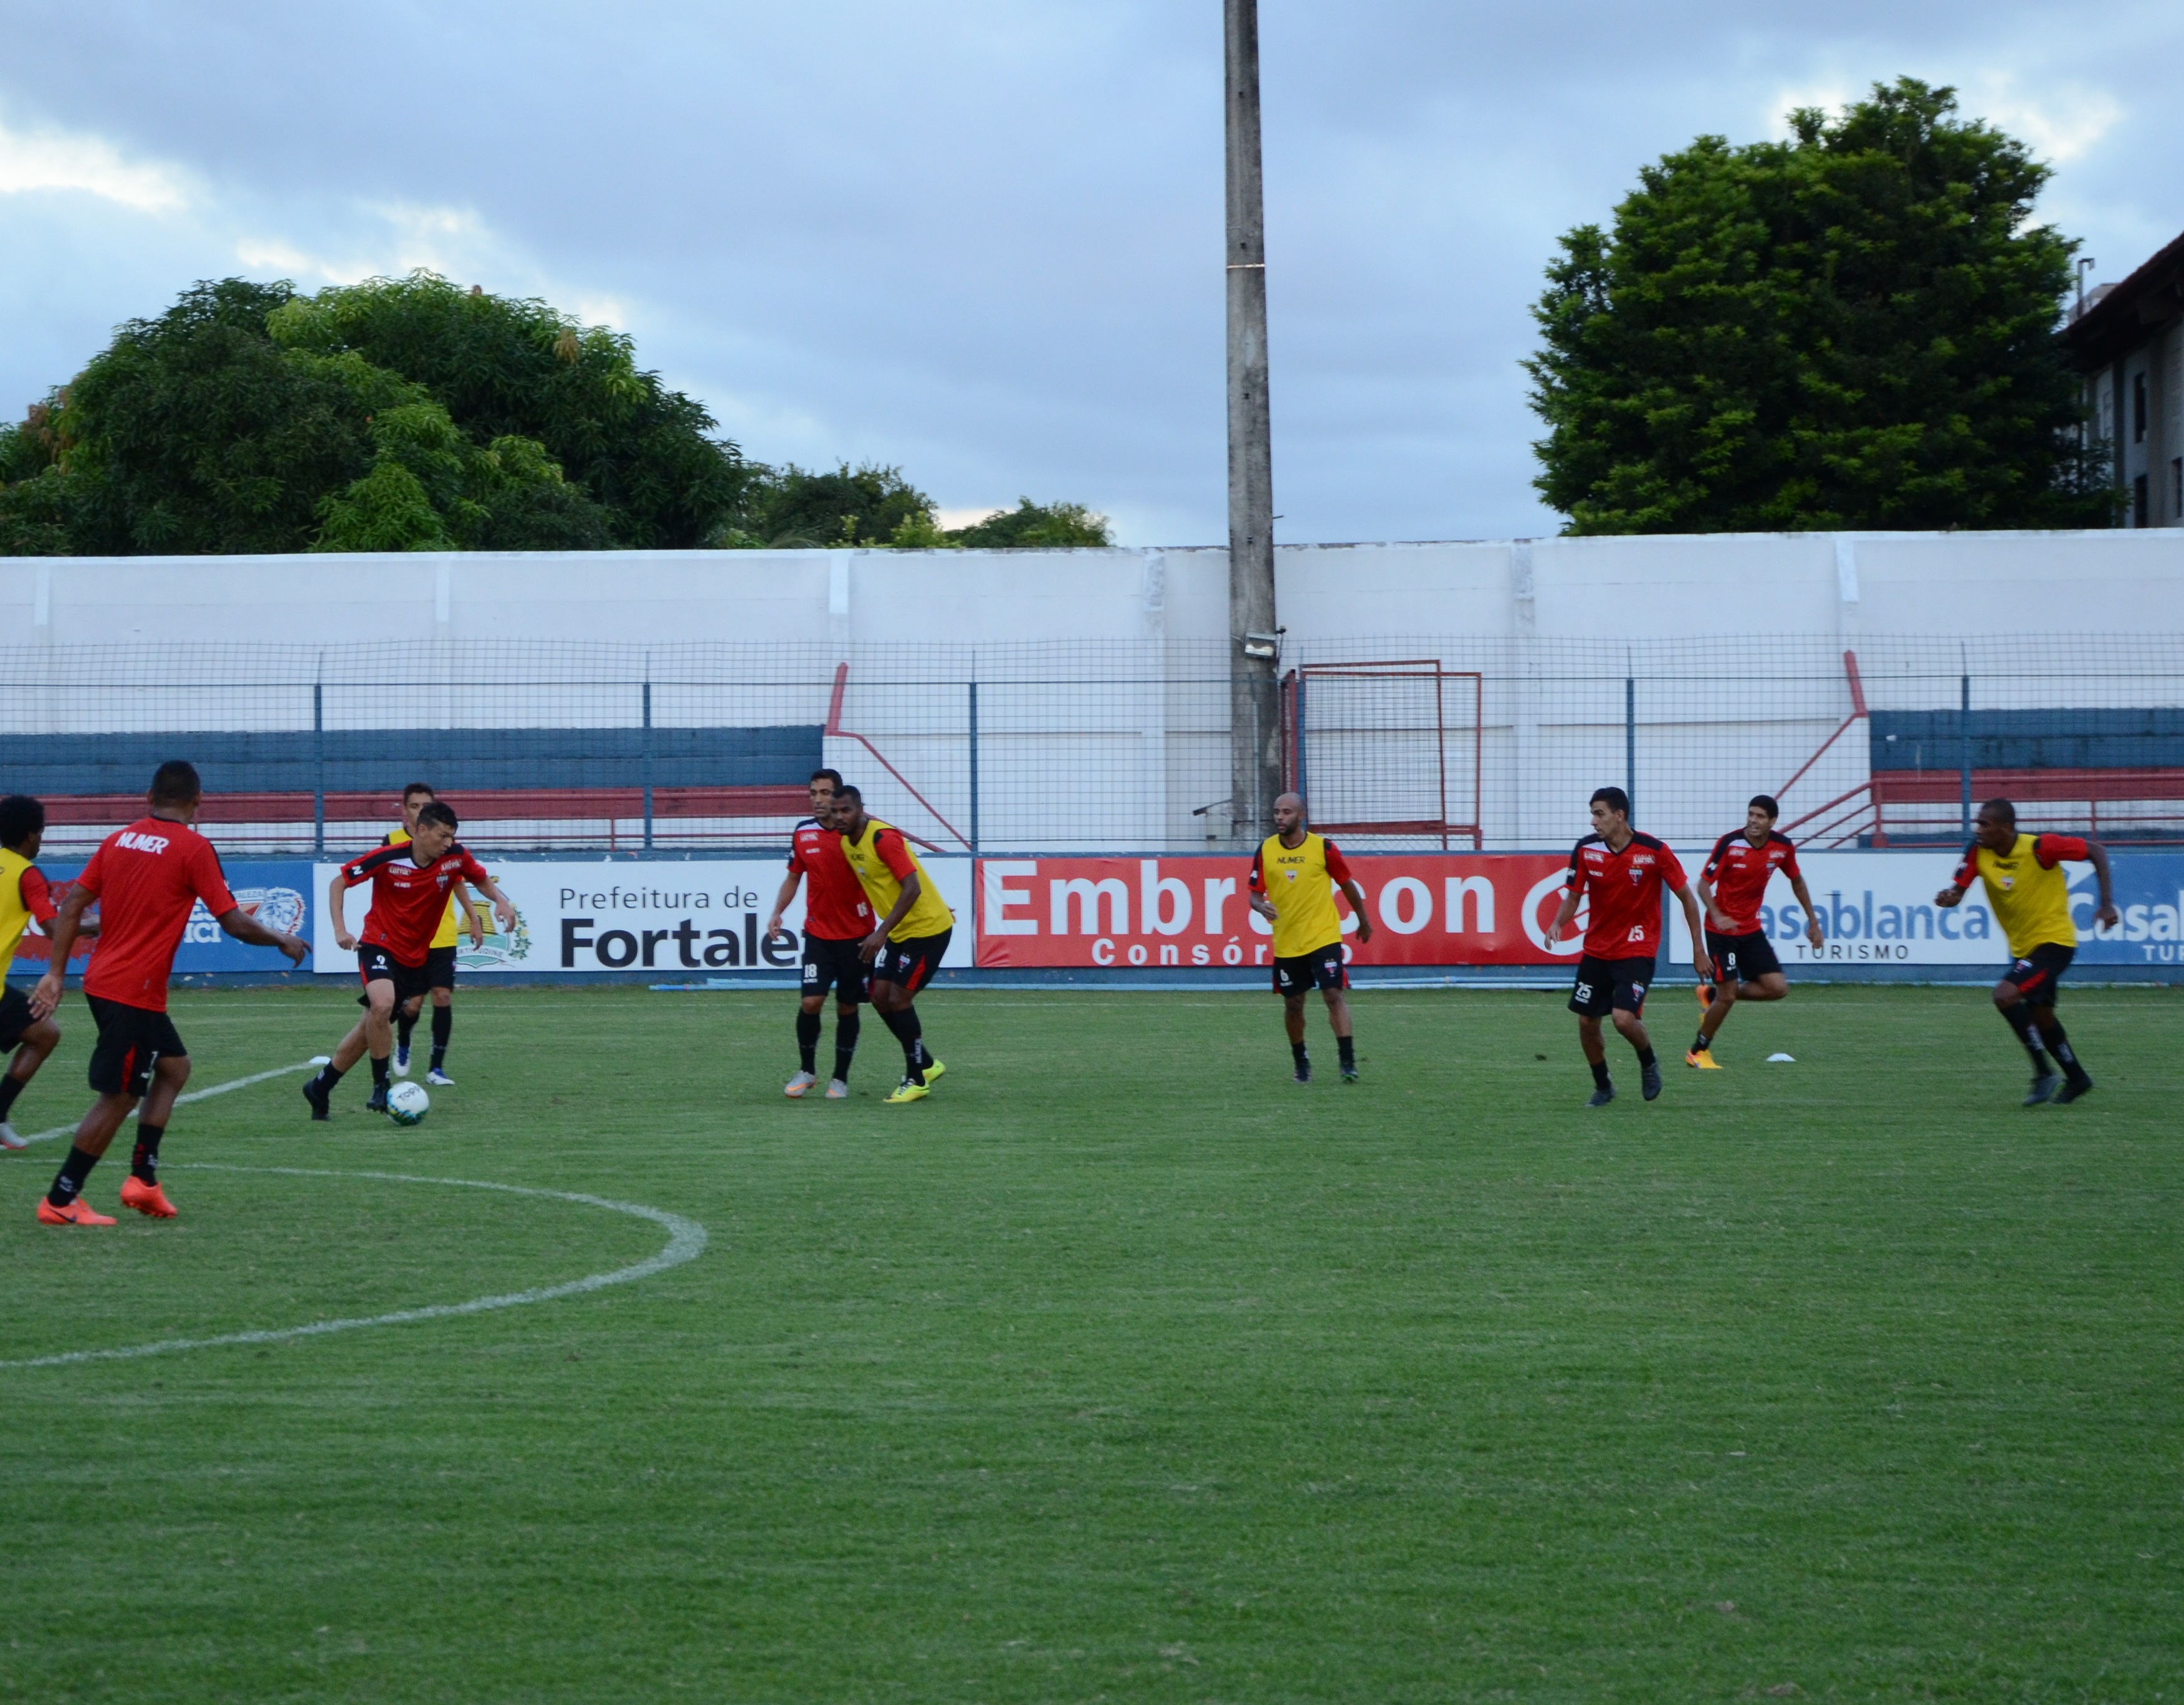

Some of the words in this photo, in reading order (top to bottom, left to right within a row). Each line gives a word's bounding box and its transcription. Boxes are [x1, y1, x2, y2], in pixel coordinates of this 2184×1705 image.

[115, 832, 169, 855] NUMER
[560, 886, 710, 909] Prefeitura
[724, 885, 758, 908] de
[983, 859, 1495, 937] Embrcon
[1758, 890, 1990, 940] asablanca
[560, 913, 805, 968] Fortale
[1091, 936, 1353, 966] Consóro
[1796, 944, 1909, 960] TURISMO
[376, 954, 386, 965] 9
[804, 963, 818, 978] 18
[1728, 952, 1736, 966] 8
